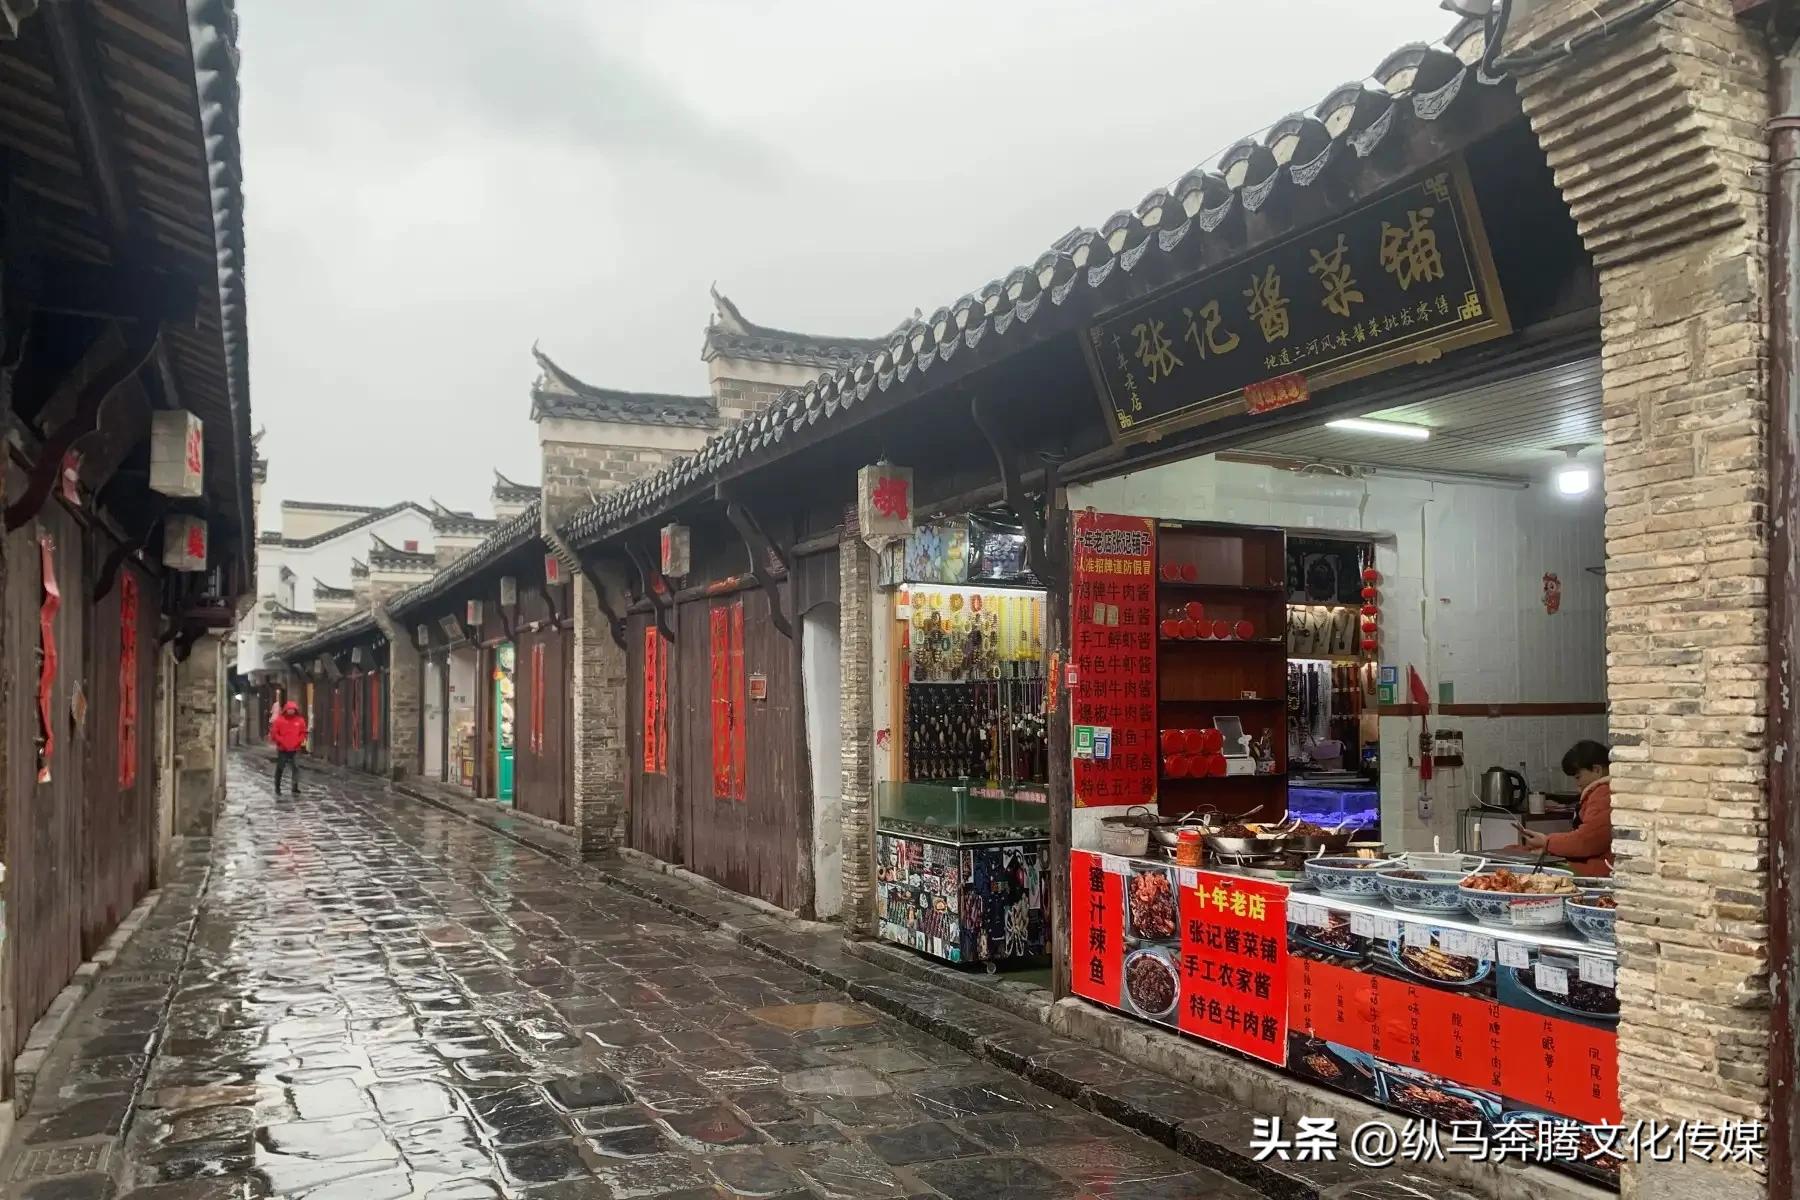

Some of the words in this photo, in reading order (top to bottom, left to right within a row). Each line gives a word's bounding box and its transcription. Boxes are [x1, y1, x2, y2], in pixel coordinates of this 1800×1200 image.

[1129, 207, 1444, 383] 张记酱菜铺
[1111, 332, 1143, 412] 十年老店
[1078, 580, 1150, 601] 招牌牛肉酱
[1080, 678, 1152, 699] 秘制牛肉酱
[1194, 884, 1267, 922] 十年老店
[1189, 919, 1279, 964] 张记酱菜铺
[1184, 954, 1272, 1000] 手工农家酱
[1190, 993, 1279, 1045] 特色牛肉酱
